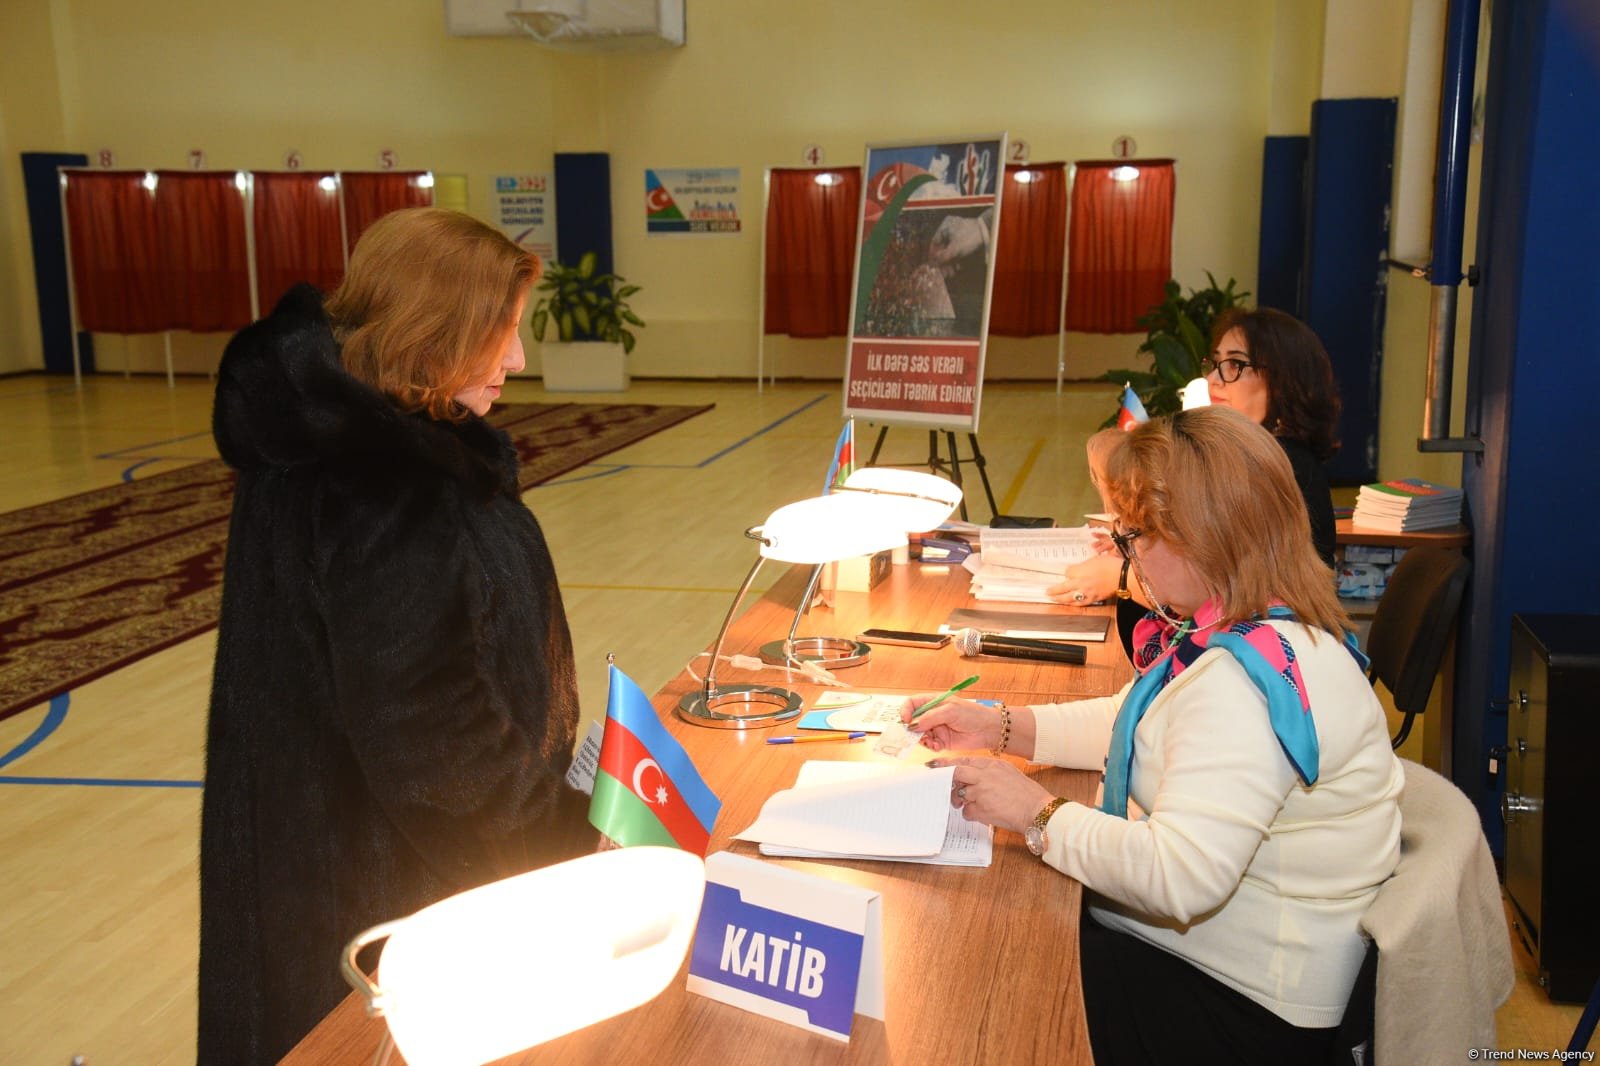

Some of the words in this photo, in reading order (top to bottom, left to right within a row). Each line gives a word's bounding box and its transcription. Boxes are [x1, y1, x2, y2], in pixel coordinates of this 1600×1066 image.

[807, 148, 818, 165] 4
[1012, 143, 1023, 160] 2
[1119, 139, 1130, 157] 1
[100, 150, 112, 168] 8
[191, 150, 202, 168] 7
[288, 151, 299, 168] 6
[382, 151, 393, 169] 5
[867, 350, 882, 371] İLK
[910, 355, 930, 374] SƏS
[720, 923, 826, 999] KATİB
